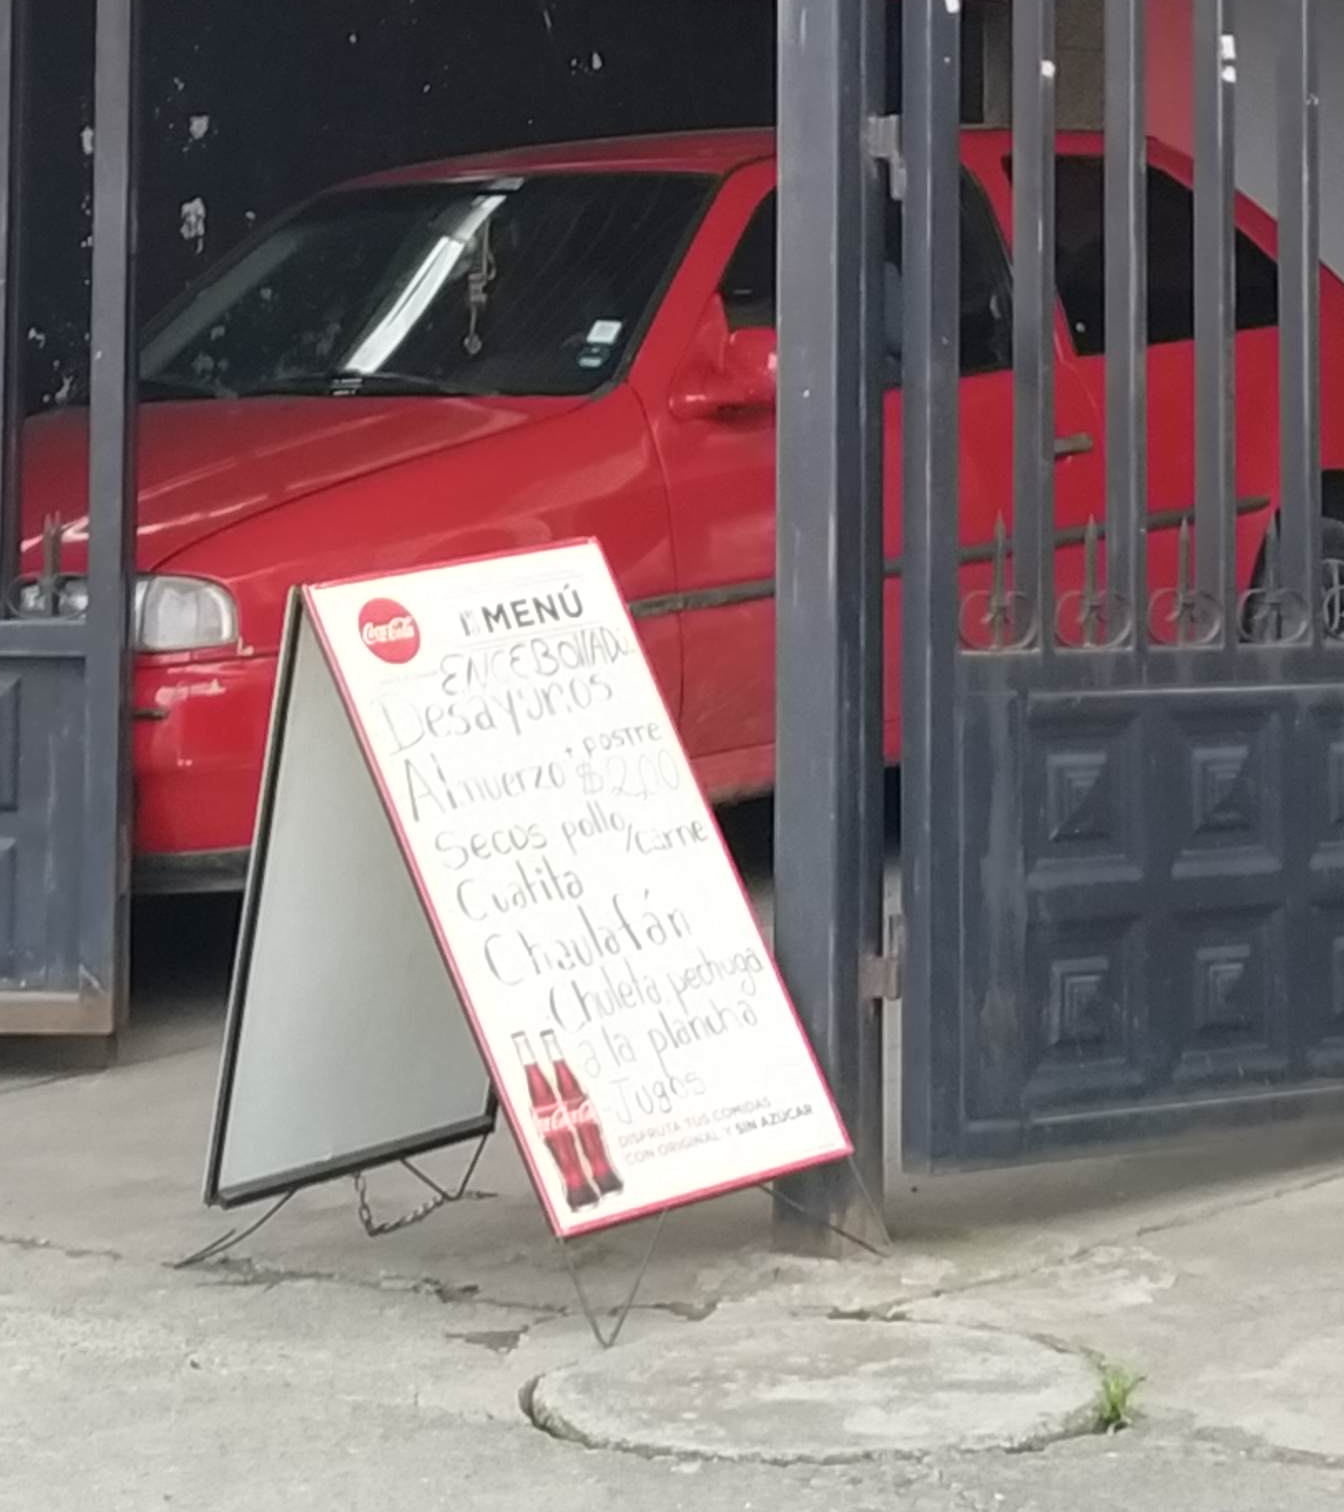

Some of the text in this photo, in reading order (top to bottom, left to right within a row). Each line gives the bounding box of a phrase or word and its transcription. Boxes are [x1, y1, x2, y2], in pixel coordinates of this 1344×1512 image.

[362, 615, 416, 646] Coca-Cola
[481, 583, 584, 634] MENÚ
[560, 800, 627, 857] pollo
[601, 1024, 637, 1069] la
[617, 1095, 773, 1149] DISFRUTA TUS COMIDAS
[624, 1149, 655, 1166] CON
[657, 1129, 721, 1157] ORIGINAL
[735, 1119, 758, 1136] SIN
